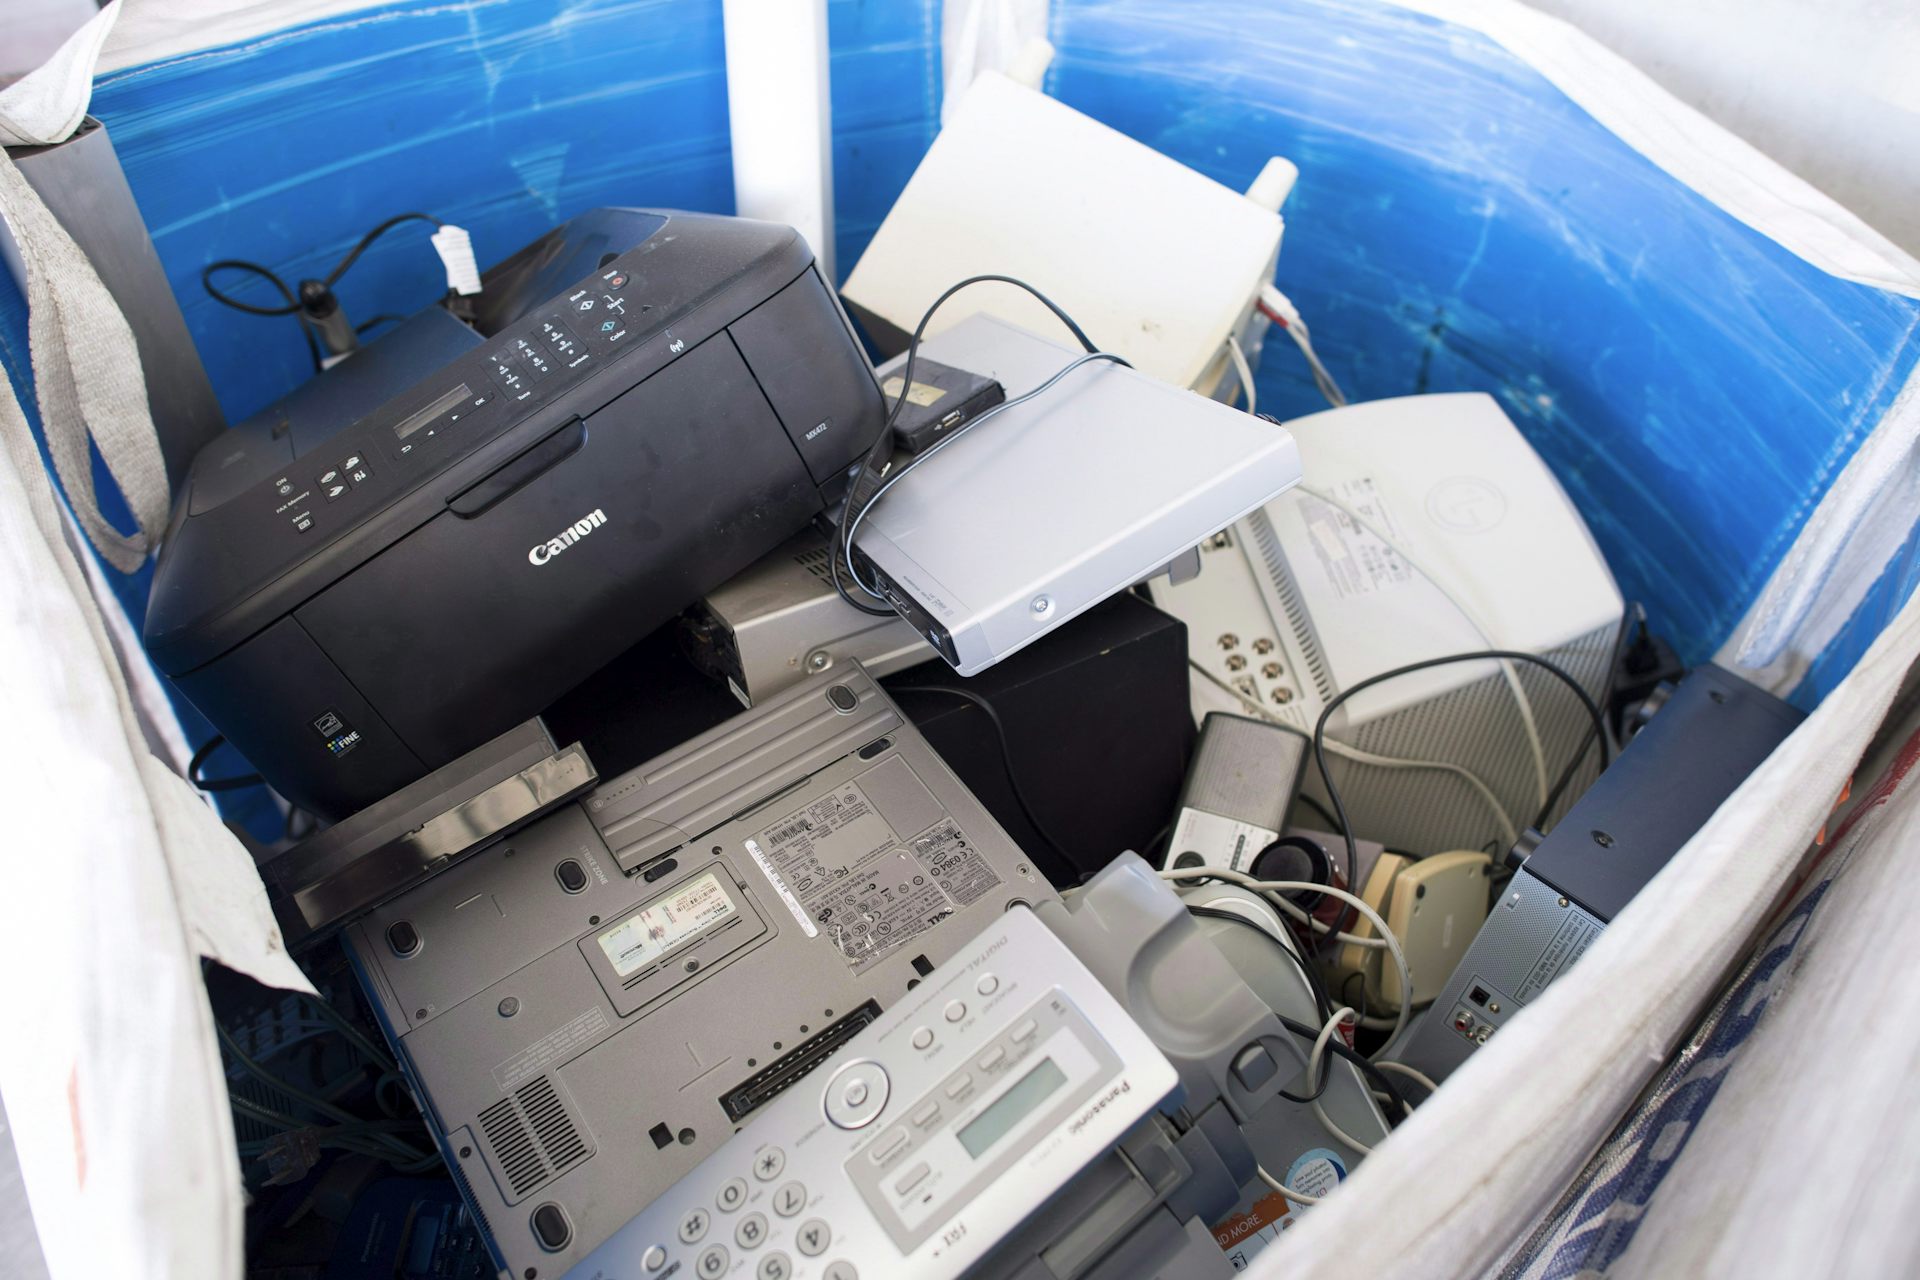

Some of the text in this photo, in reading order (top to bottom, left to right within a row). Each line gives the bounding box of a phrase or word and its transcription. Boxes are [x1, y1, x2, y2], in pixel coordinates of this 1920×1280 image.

[603, 269, 618, 281] Stop
[569, 288, 586, 302] Black
[606, 296, 624, 310] Start
[609, 329, 626, 342] Color
[569, 353, 589, 368] Symbols
[474, 396, 485, 406] OK
[517, 390, 531, 401] Tone
[275, 477, 287, 486] ON
[275, 490, 310, 514] FAX Memory
[292, 510, 310, 523] Menu
[528, 508, 608, 566] Canon
[337, 731, 360, 749] FINE
[939, 854, 960, 871] 0984
[592, 865, 608, 885] ZONE
[965, 935, 1009, 973] DIGITAL
[957, 1015, 977, 1033] HELP
[923, 1043, 944, 1061] MENU
[1068, 1079, 1130, 1136] Panasonic
[722, 1185, 740, 1204] 0
[779, 1188, 798, 1209] 7
[684, 1214, 704, 1235] #
[741, 1220, 761, 1241] 8
[361, 1212, 382, 1263] Panasonic
[804, 1226, 824, 1247] 4
[702, 1251, 722, 1272] 9
